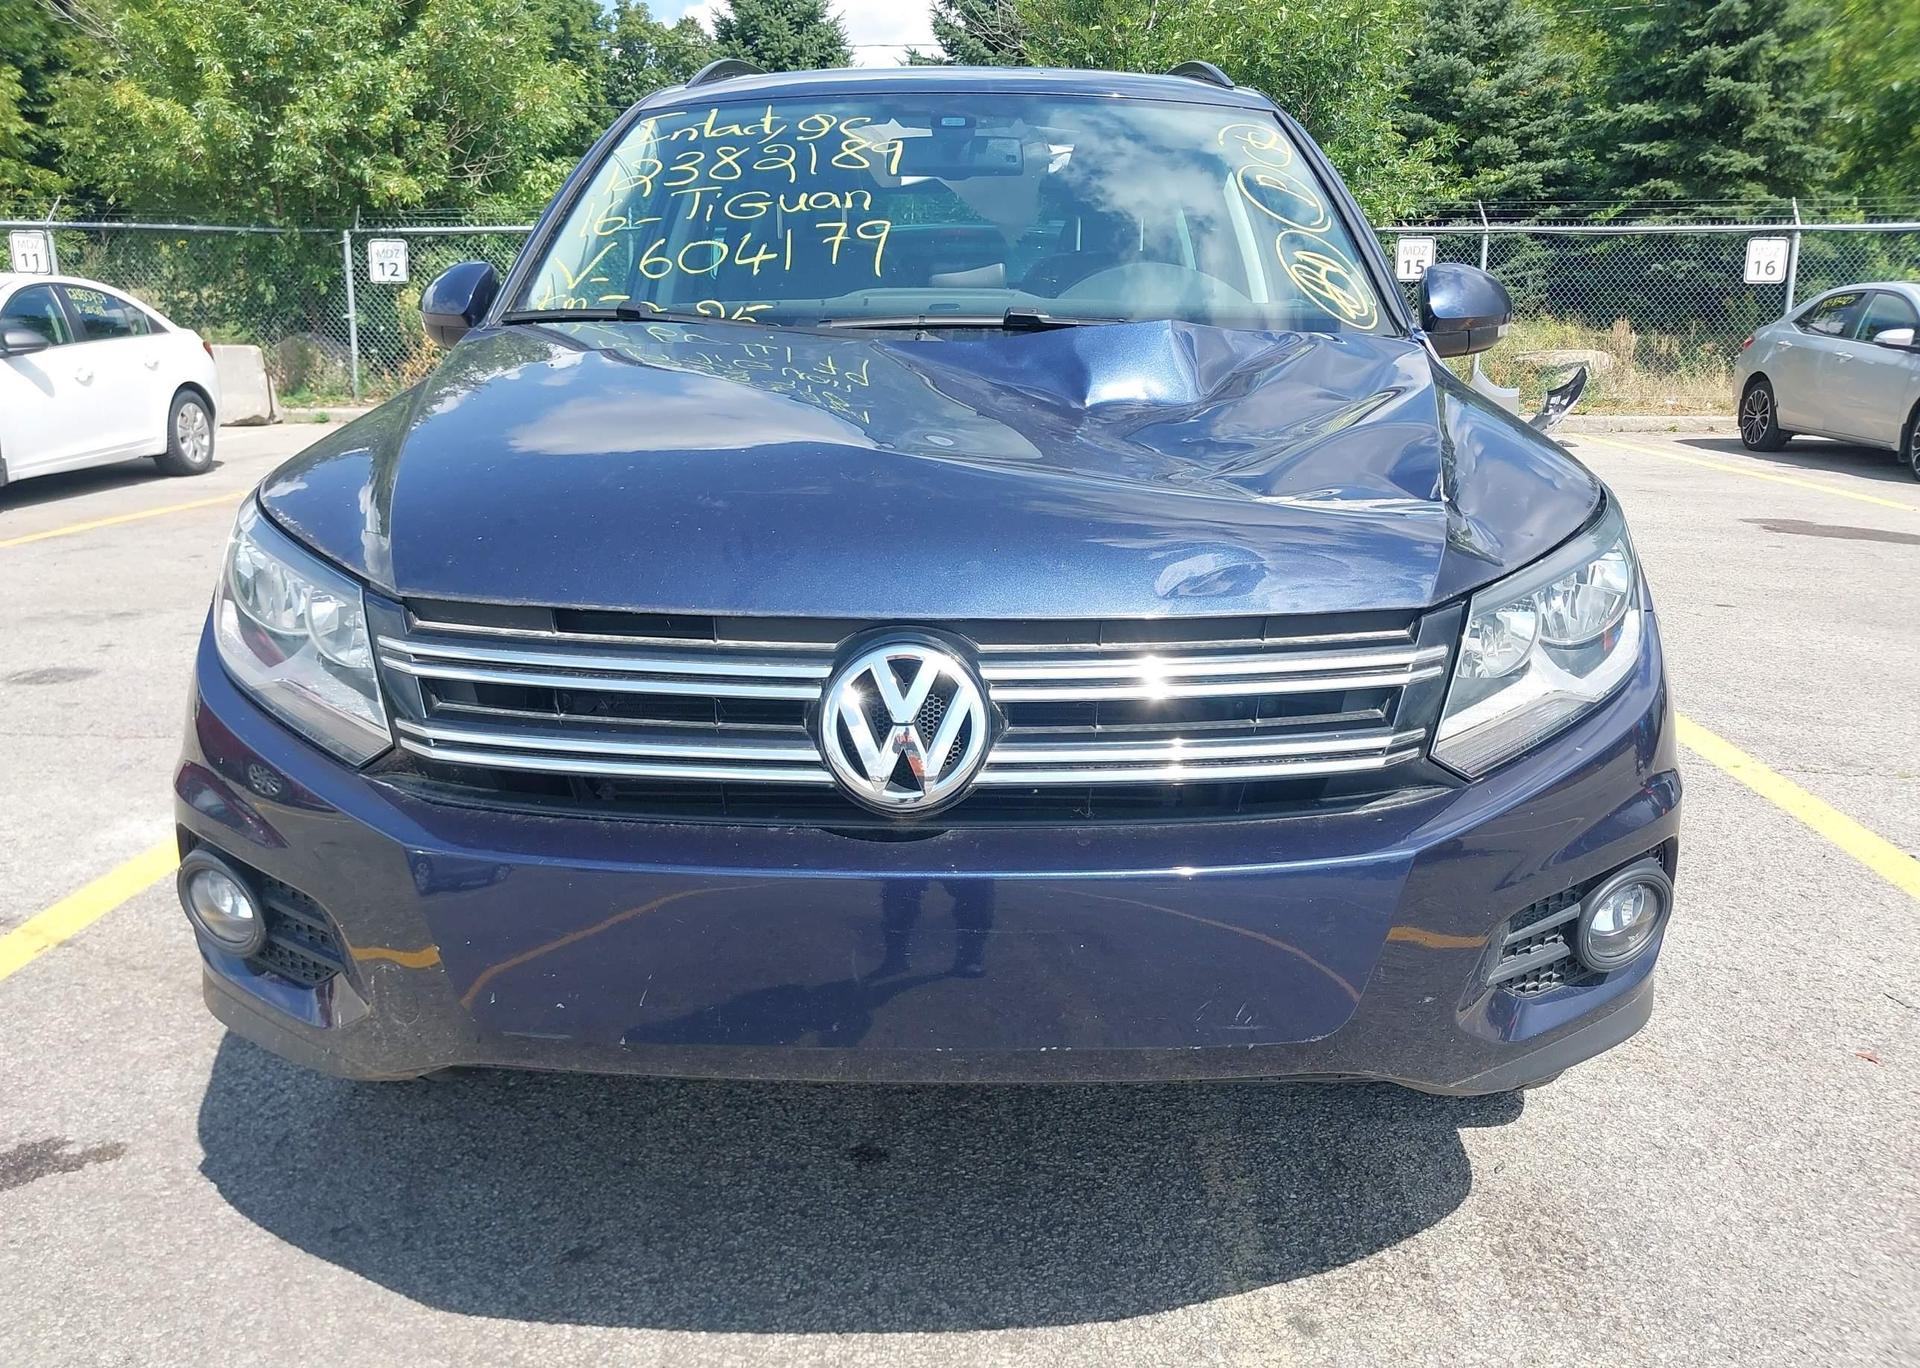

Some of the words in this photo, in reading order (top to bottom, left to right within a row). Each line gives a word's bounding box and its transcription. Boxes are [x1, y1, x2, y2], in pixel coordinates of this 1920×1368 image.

[376, 248, 401, 258] MDZ
[1402, 245, 1428, 256] MDZ
[21, 253, 40, 268] 11
[1403, 259, 1425, 275] 15
[1754, 260, 1776, 276] 16
[378, 262, 400, 277] 12
